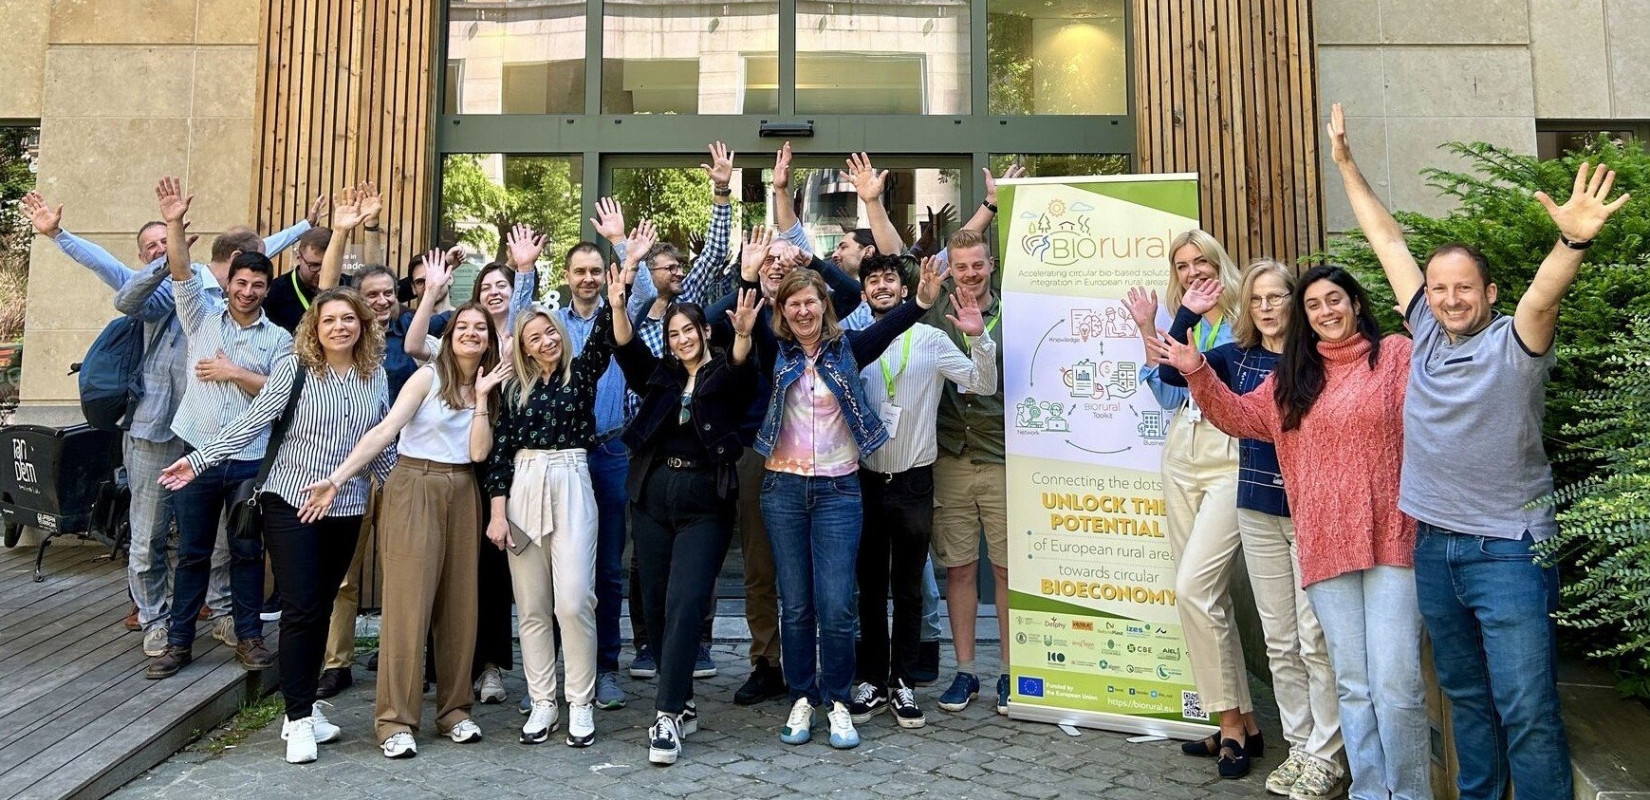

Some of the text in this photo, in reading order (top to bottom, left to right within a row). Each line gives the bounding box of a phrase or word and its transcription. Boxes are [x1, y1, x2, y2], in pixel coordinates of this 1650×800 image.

[1053, 229, 1172, 259] BIOrural
[1018, 269, 1170, 278] Accelerating circular bio-based solutio
[1030, 279, 1072, 287] integration
[1084, 279, 1124, 287] European
[1048, 336, 1080, 344] Knowledge
[1092, 411, 1113, 419] Toolkit
[1031, 471, 1163, 491] Connecting the dots
[1042, 491, 1167, 517] UNLOCK THE
[1050, 513, 1165, 538] POTENTIAL
[1033, 537, 1048, 551] of
[1050, 539, 1113, 557] European
[1117, 545, 1145, 558] rural
[1059, 565, 1160, 583] towards circular
[1040, 578, 1177, 607] BIOECONOMY
[1044, 619, 1066, 630] Delphy
[1126, 625, 1143, 633] izes
[1137, 646, 1152, 654] CBE
[1046, 682, 1074, 692] Funded by
[1055, 690, 1081, 699] European
[1107, 696, 1174, 712] https://biorural.eu
